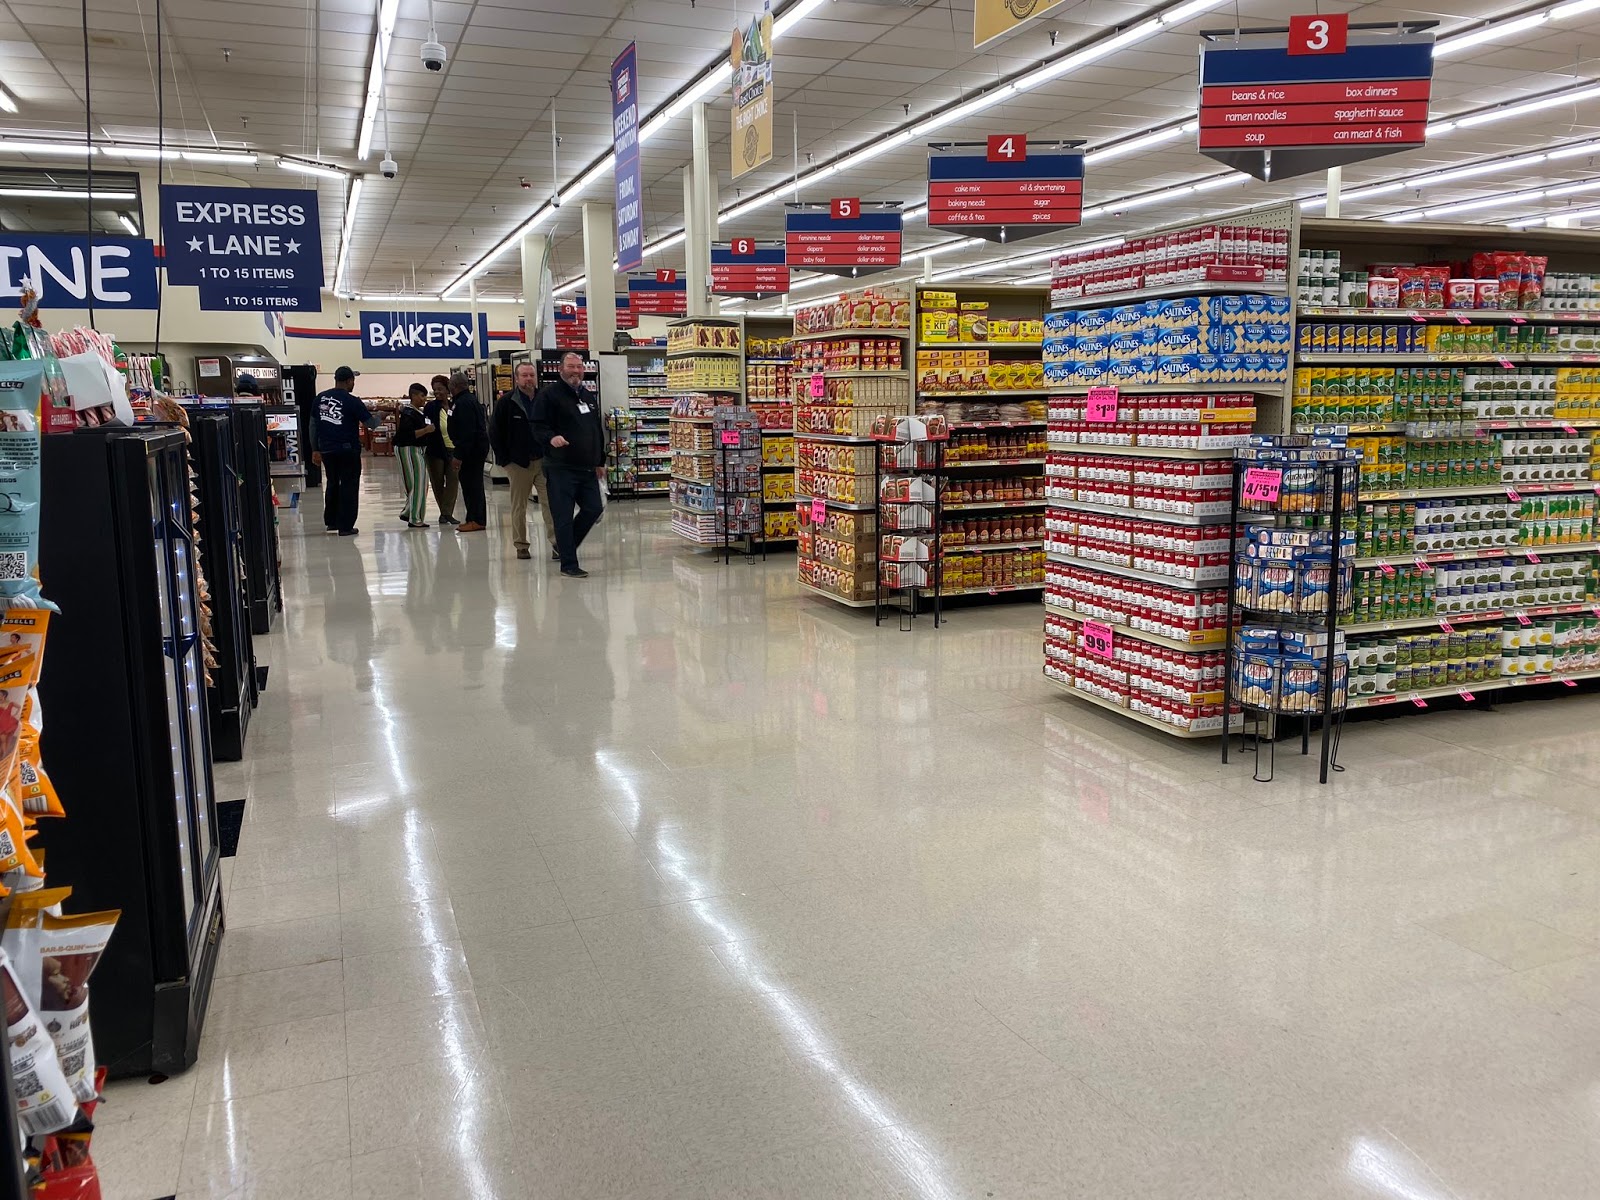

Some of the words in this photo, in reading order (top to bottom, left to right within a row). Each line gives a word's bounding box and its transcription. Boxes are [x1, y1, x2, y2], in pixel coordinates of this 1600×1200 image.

[1306, 20, 1329, 50] 3
[749, 84, 762, 100] Choice
[1231, 90, 1259, 101] beans
[1259, 90, 1266, 100] &
[1268, 89, 1285, 100] rice
[1346, 87, 1363, 97] box
[1365, 86, 1398, 97] dinners
[1225, 112, 1252, 122] ramen
[1254, 110, 1287, 121] noodles
[1334, 107, 1377, 120] spaghetti
[1379, 107, 1404, 118] sauce
[614, 103, 636, 138] WEEKEND
[1245, 132, 1265, 143] soup
[1334, 130, 1349, 140] can
[1351, 128, 1374, 139] meat
[1375, 127, 1383, 138] &
[1384, 126, 1402, 138] fish
[998, 137, 1015, 158] 4
[954, 185, 968, 193] cake
[839, 200, 851, 216] 5
[948, 199, 967, 208] baking
[968, 199, 986, 207] needs
[1033, 199, 1050, 209] sugar
[176, 201, 306, 226] EXPRESS
[947, 213, 968, 221] coffee
[1032, 212, 1051, 221] spices
[208, 234, 282, 256] LANE
[738, 240, 748, 253] 6
[803, 256, 814, 264] baby
[200, 268, 206, 278] 1
[210, 267, 230, 278] TO
[234, 268, 249, 278] 15
[252, 268, 294, 279] ITEMS
[662, 270, 670, 282] 7
[224, 297, 229, 306] 1
[233, 297, 248, 306] TO
[251, 297, 263, 306] 15
[265, 297, 298, 306] ITEMS
[565, 306, 571, 314] 9
[1164, 306, 1192, 318] SALTINES
[1080, 317, 1105, 327] SALTINES
[1116, 312, 1140, 322] SALTINES
[934, 322, 946, 330] KIT
[1047, 319, 1070, 328] SALTINES
[369, 322, 474, 348] BAKERY
[1163, 334, 1190, 344] SALTINES
[1046, 344, 1068, 353] SALTINES
[1079, 342, 1102, 352] SALTINES
[1114, 340, 1139, 350] SALTINES
[1078, 367, 1101, 376] SALTINES
[1112, 365, 1136, 375] SALTINES
[1162, 363, 1190, 373] SALTINES
[261, 369, 278, 378] WINE
[1046, 369, 1068, 378] SALTINES
